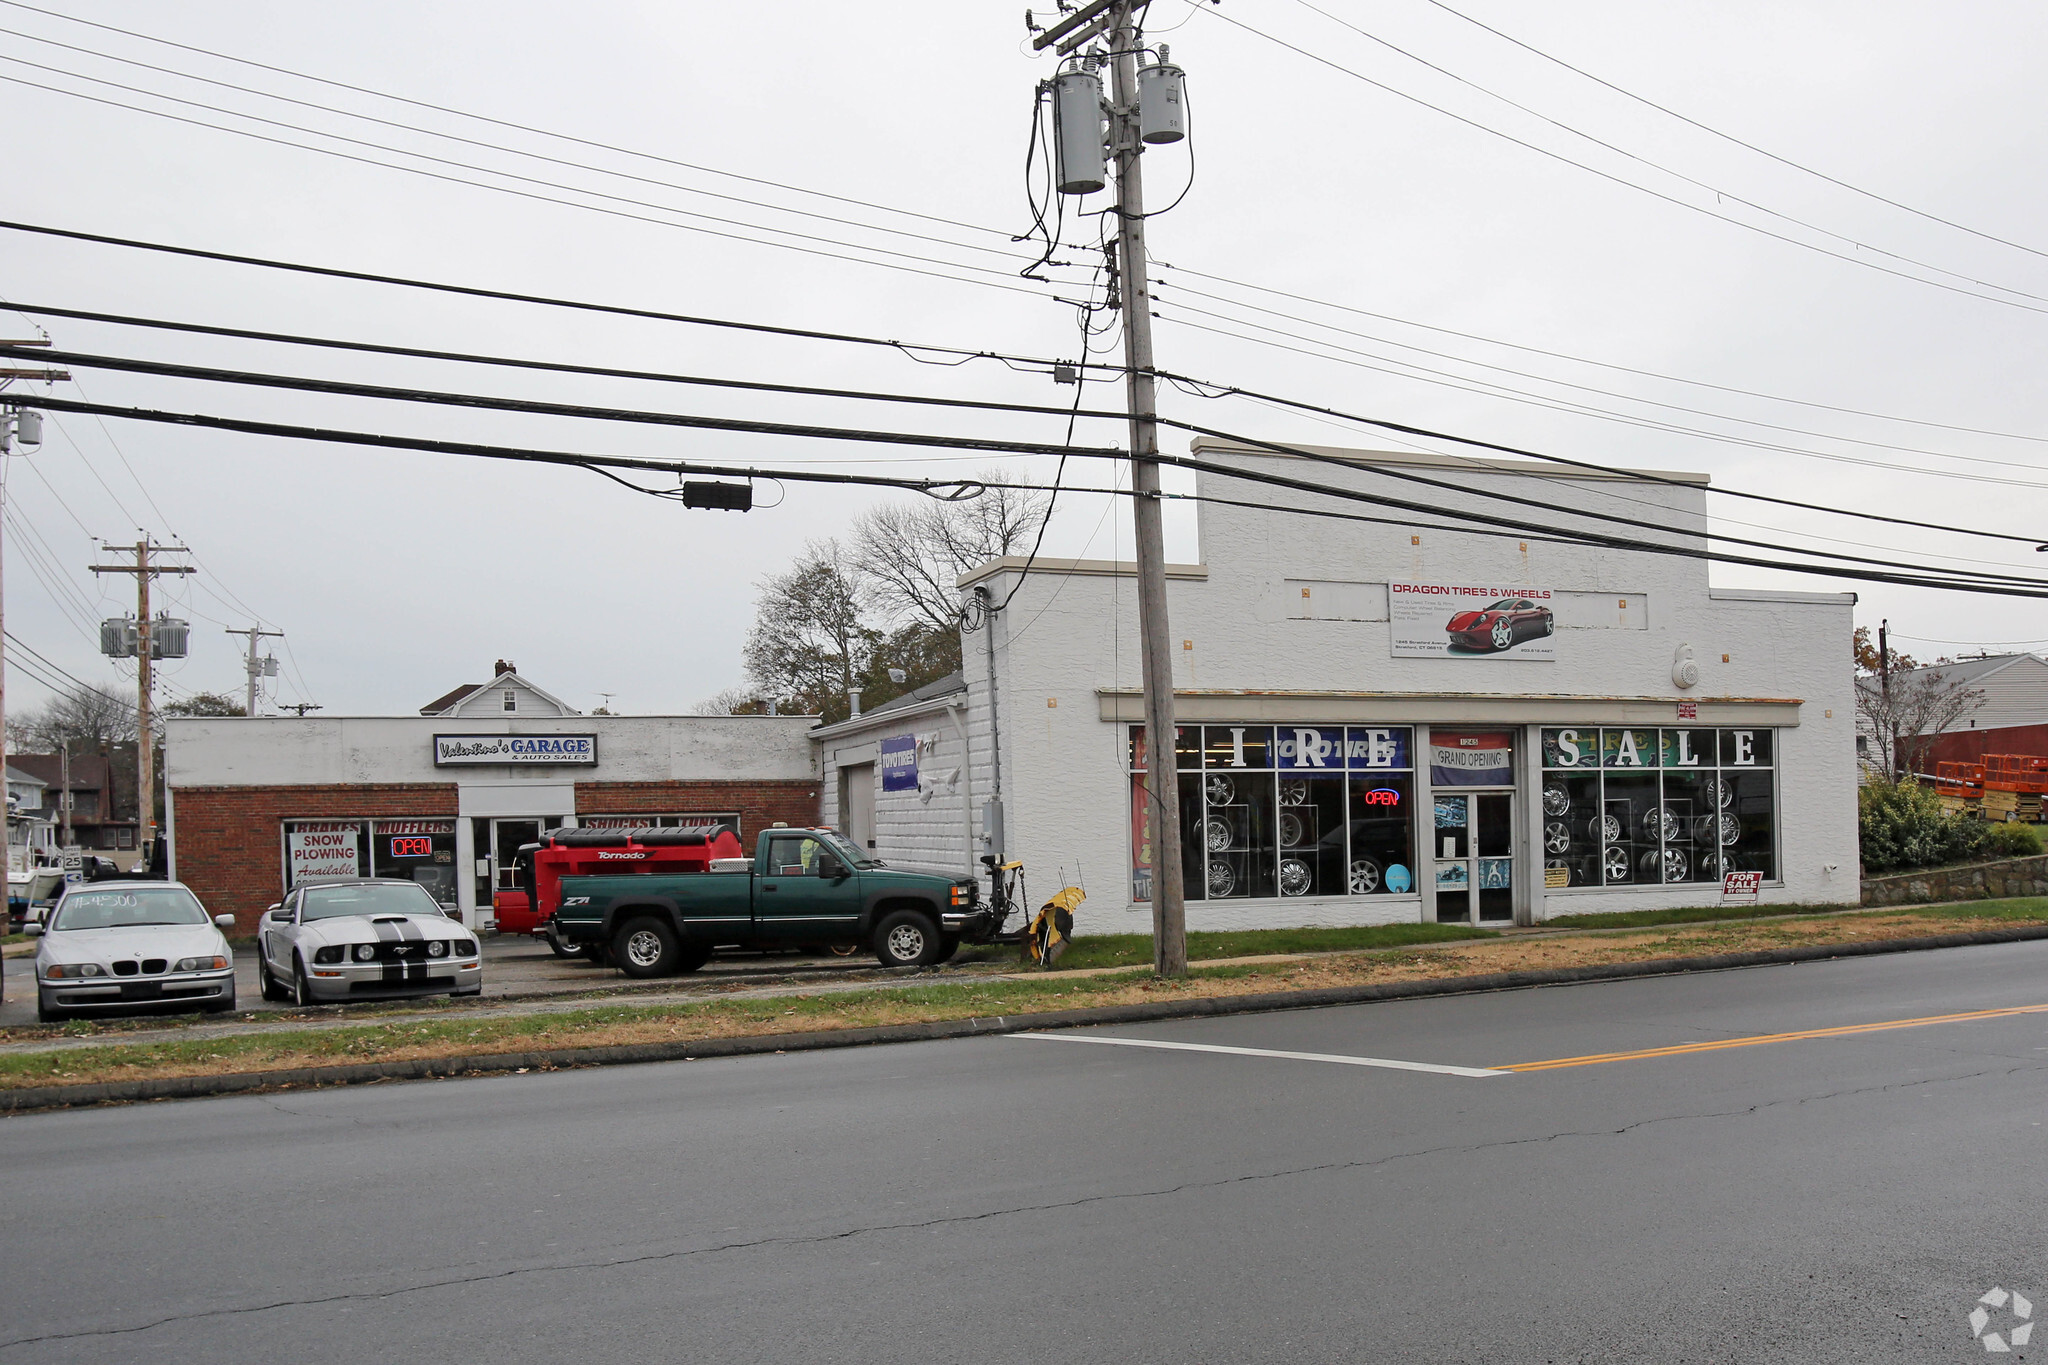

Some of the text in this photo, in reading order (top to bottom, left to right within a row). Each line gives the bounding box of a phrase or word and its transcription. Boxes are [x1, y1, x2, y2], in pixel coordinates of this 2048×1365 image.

[1169, 119, 1178, 127] 50
[1393, 584, 1551, 599] DRAGON TIRES & WHEELS
[439, 739, 590, 758] Valentino's GARAGE
[882, 748, 915, 769] TOYO TIRES
[1438, 750, 1502, 767] GRAND OPENING
[1365, 791, 1398, 806] OPEN
[296, 822, 360, 833] BRAKES
[375, 821, 454, 834] MUFFLERS
[586, 817, 650, 830] SHOCKS
[304, 834, 344, 846] SNOW
[393, 838, 431, 855] OPEN
[294, 847, 355, 860] PLOWING
[598, 852, 646, 860] Tornado
[65, 857, 81, 867] 25
[296, 862, 355, 877] Available
[1726, 880, 1758, 889] SALE
[563, 896, 591, 906] Z71
